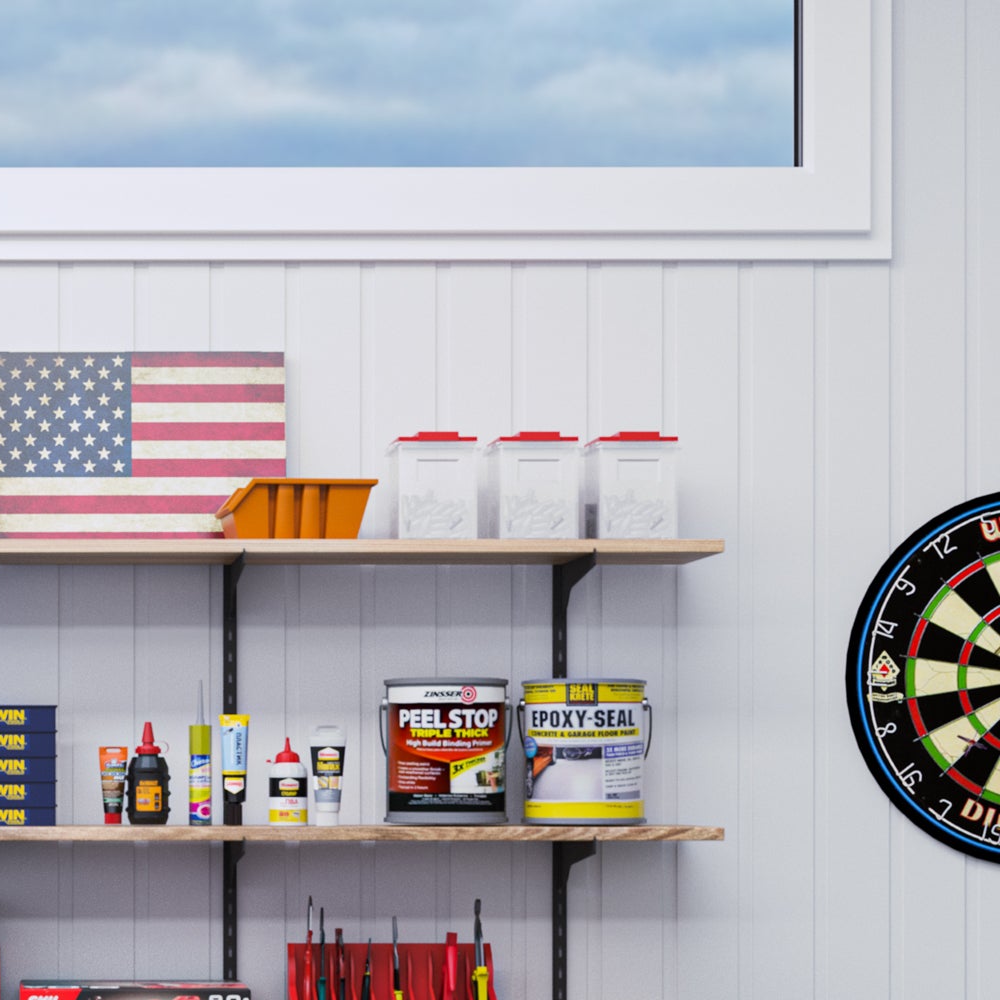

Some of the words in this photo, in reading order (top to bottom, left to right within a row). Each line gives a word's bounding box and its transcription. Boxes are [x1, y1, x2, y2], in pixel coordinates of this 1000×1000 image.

[923, 534, 958, 559] 12
[399, 709, 447, 729] PEEL
[449, 709, 498, 729] STOP
[532, 710, 636, 728] EPOXY-SEAL
[410, 729, 453, 738] TRIPLE
[455, 729, 489, 738] THICK
[876, 722, 898, 738] 8
